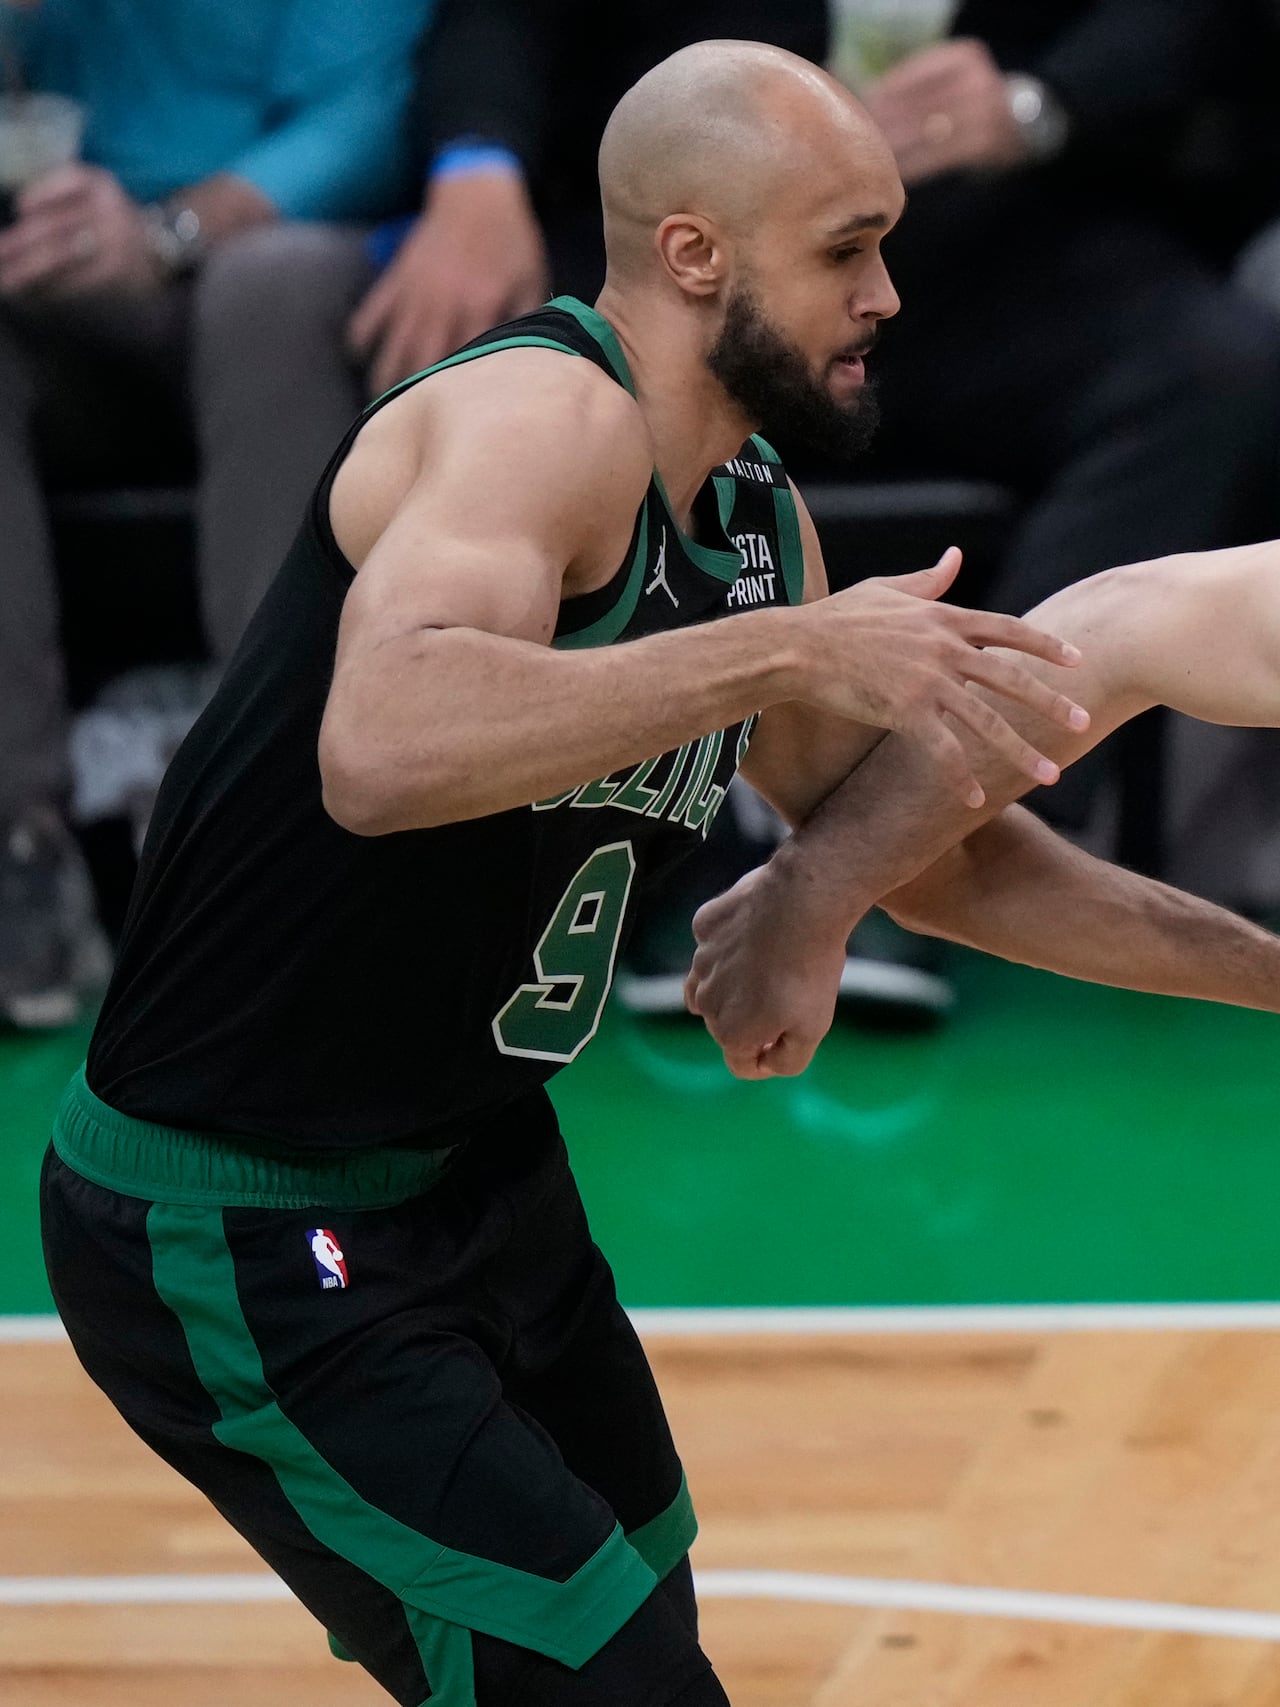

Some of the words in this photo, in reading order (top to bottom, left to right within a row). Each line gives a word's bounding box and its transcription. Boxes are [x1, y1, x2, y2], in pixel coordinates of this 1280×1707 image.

[724, 458, 774, 484] WALTON
[731, 533, 774, 570] STA
[491, 840, 636, 1063] 9
[322, 1275, 338, 1289] NBA
